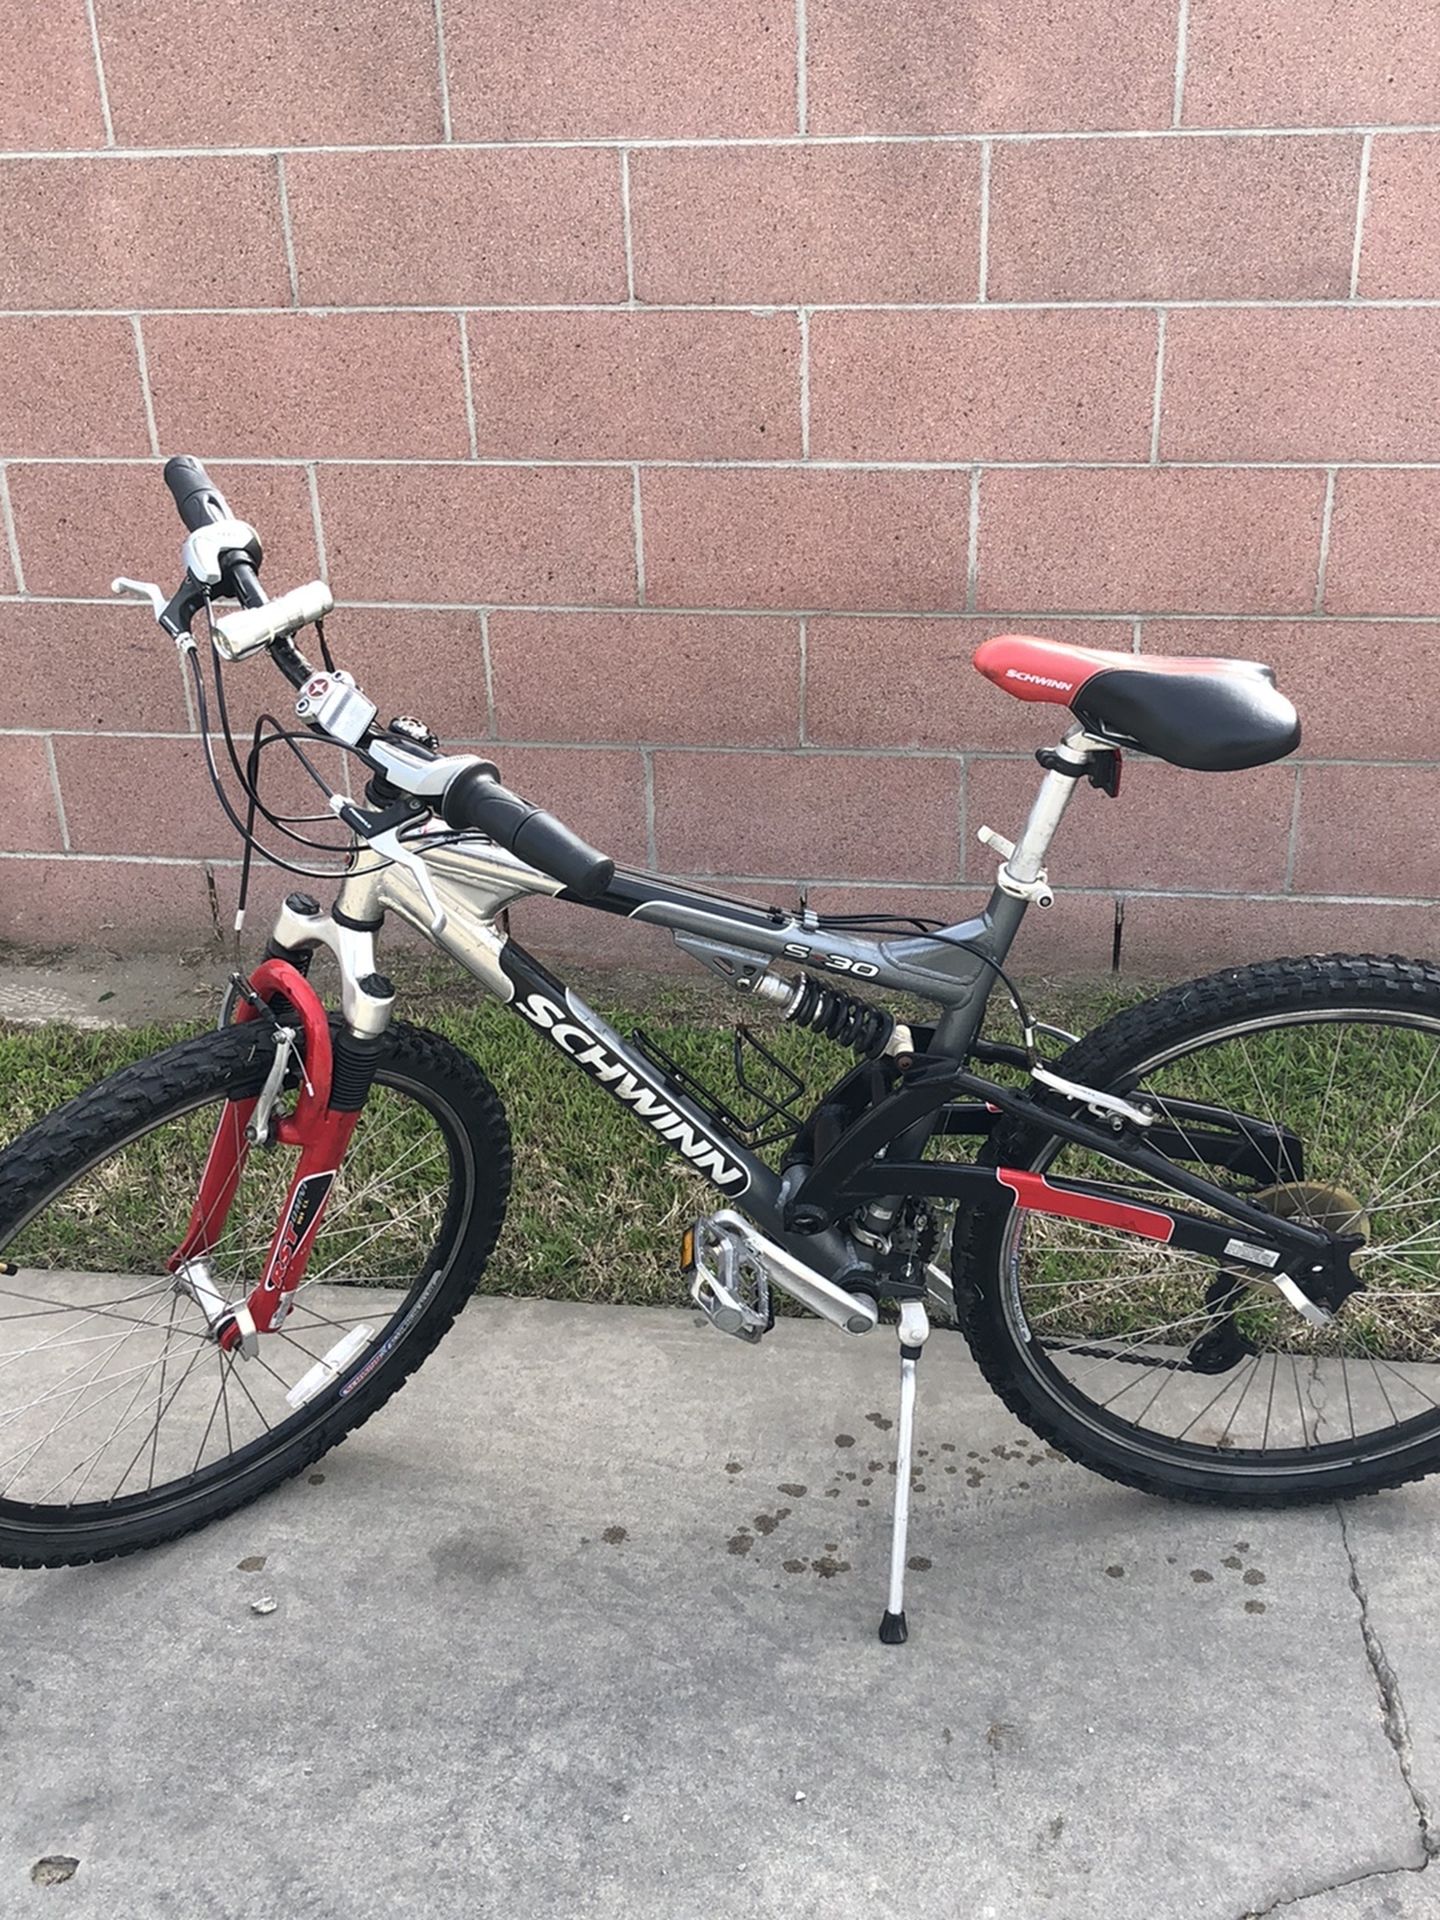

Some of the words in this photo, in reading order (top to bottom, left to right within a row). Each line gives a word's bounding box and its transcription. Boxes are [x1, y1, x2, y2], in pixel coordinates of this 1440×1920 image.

[1005, 669, 1073, 691] SCHWINN
[516, 994, 743, 1184] SCHWINN
[272, 1222, 298, 1288] RST
